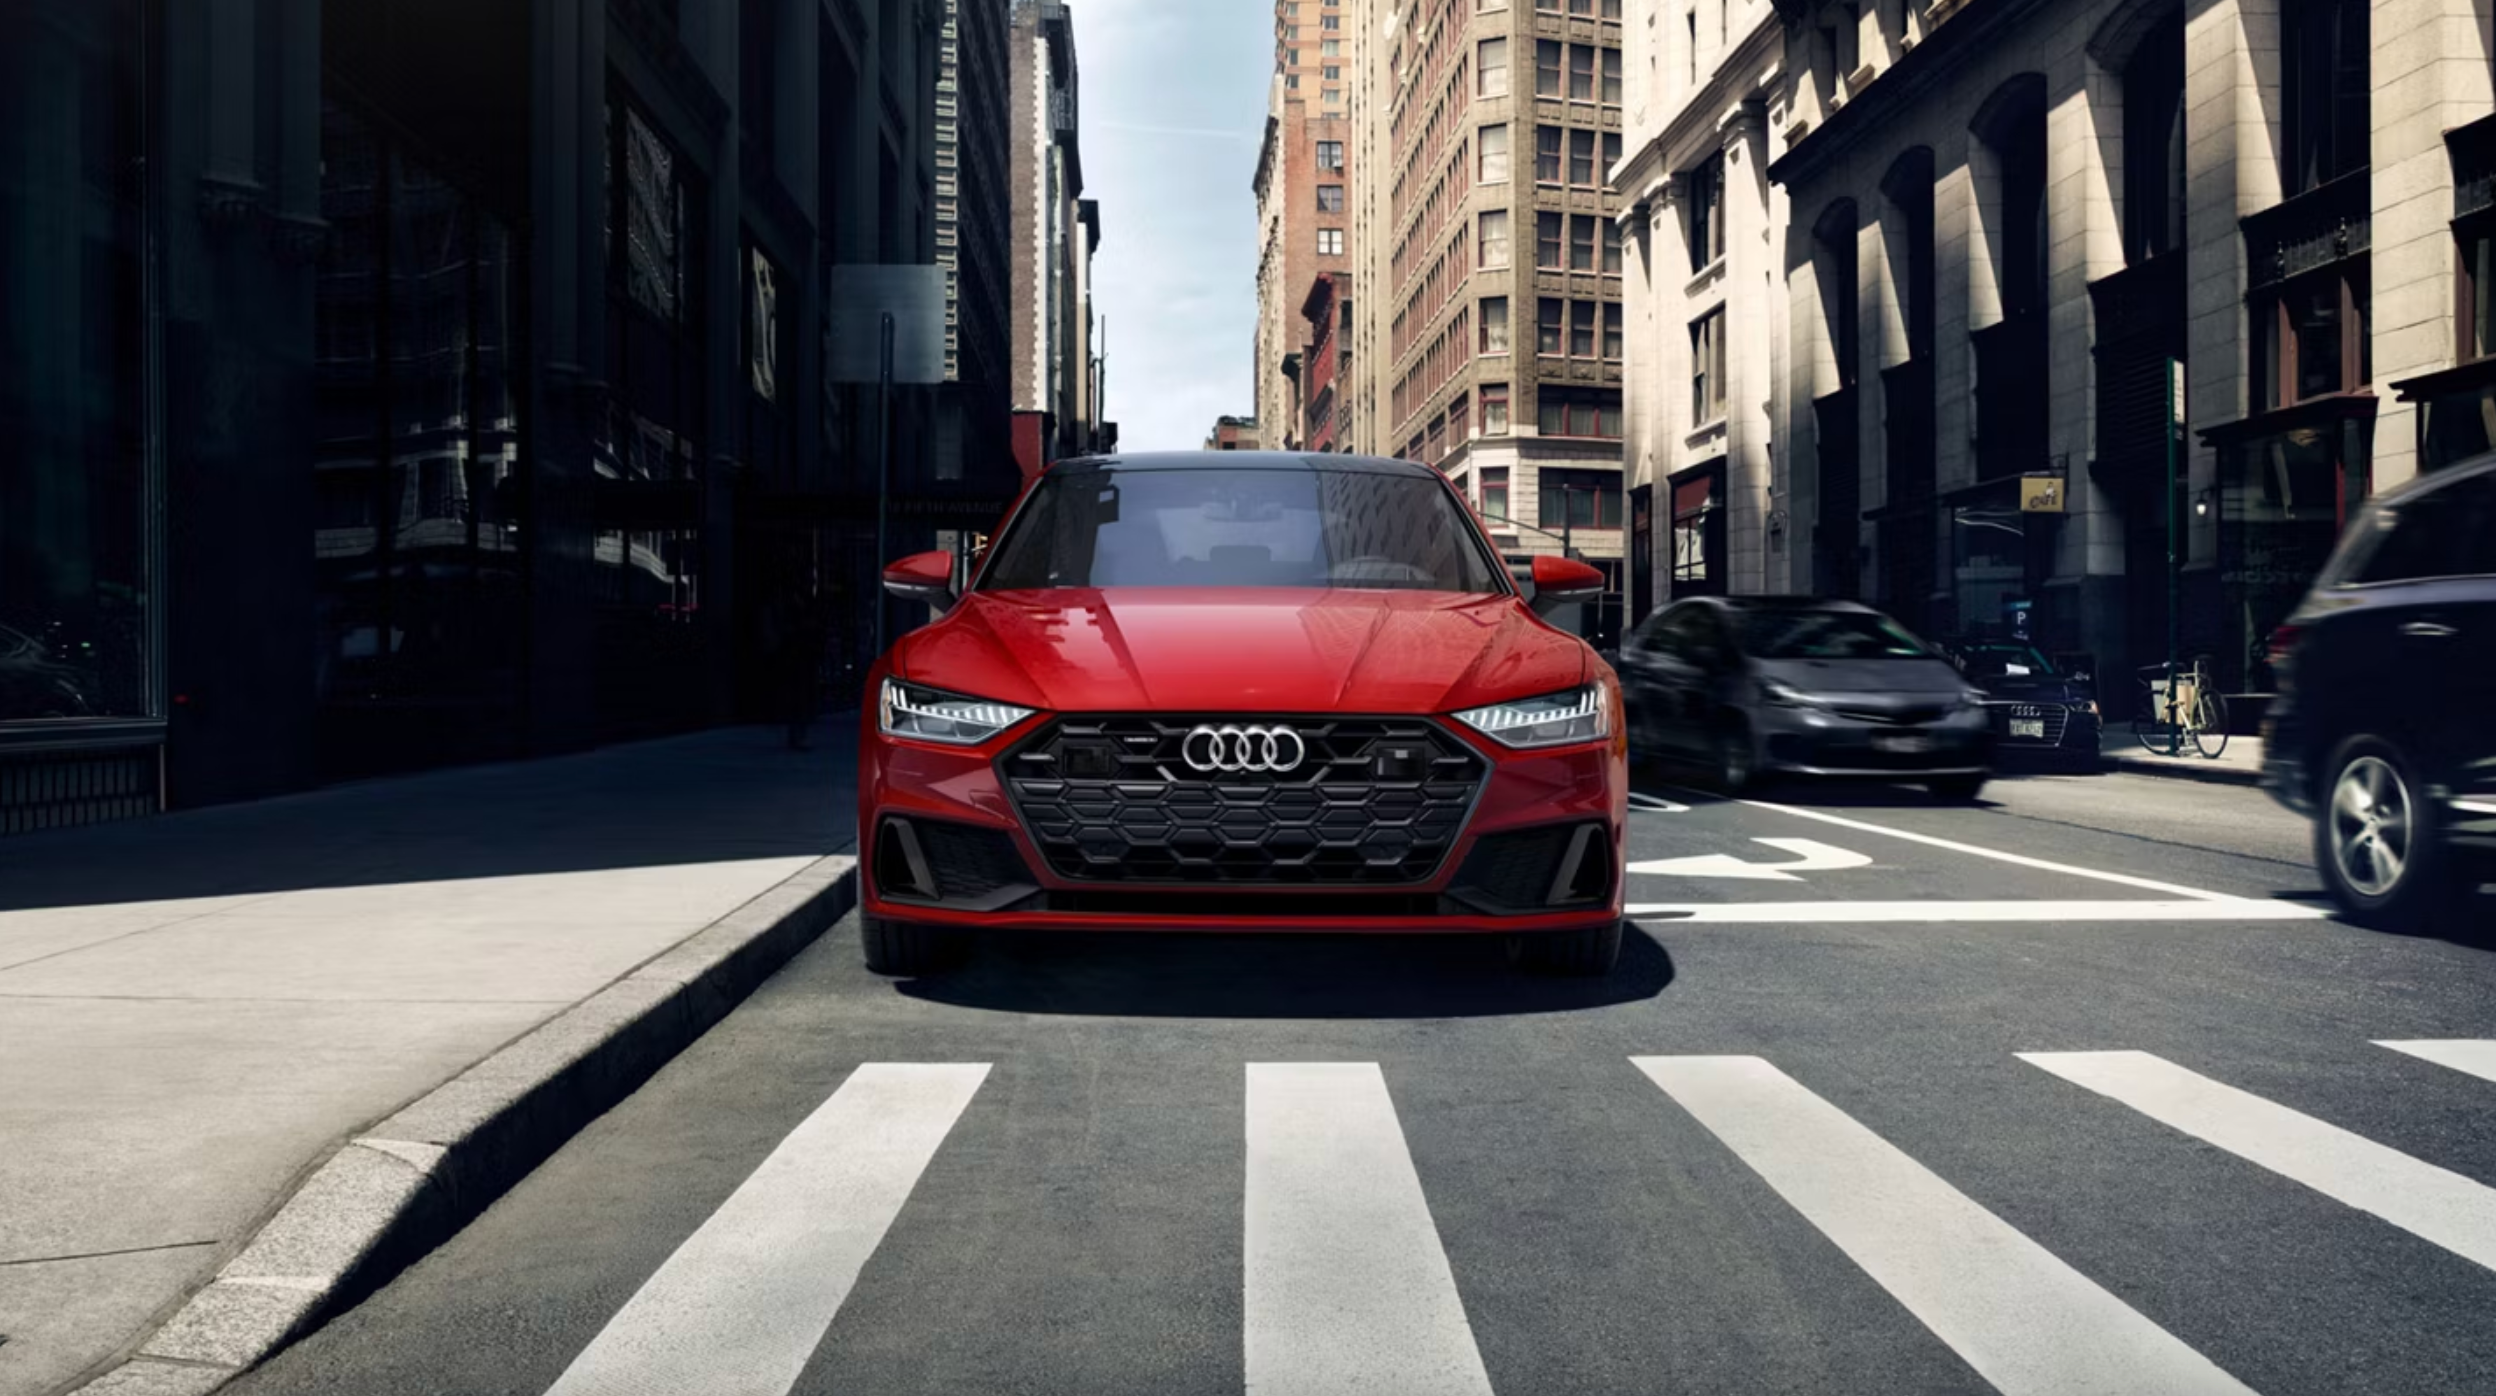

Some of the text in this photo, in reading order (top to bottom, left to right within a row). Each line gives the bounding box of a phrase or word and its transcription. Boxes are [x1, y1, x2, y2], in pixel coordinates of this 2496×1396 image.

[904, 500, 943, 514] FIFTH
[947, 500, 1003, 514] AVENUE
[2017, 611, 2027, 625] P
